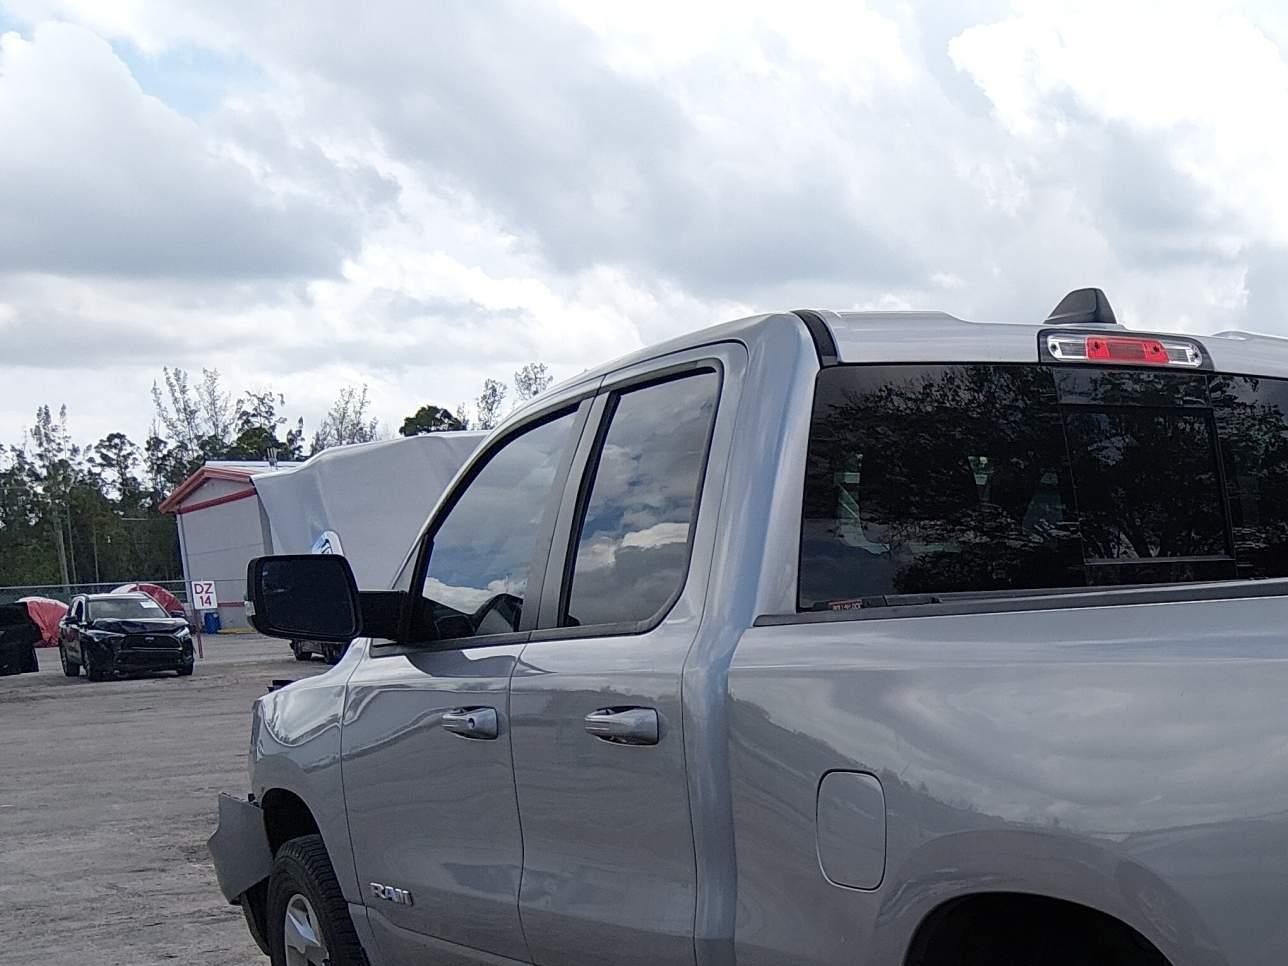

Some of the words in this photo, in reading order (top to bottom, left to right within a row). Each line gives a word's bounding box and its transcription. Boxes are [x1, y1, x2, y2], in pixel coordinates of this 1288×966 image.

[194, 583, 214, 595] DZ
[199, 595, 212, 607] 14
[368, 882, 415, 905] RAM
